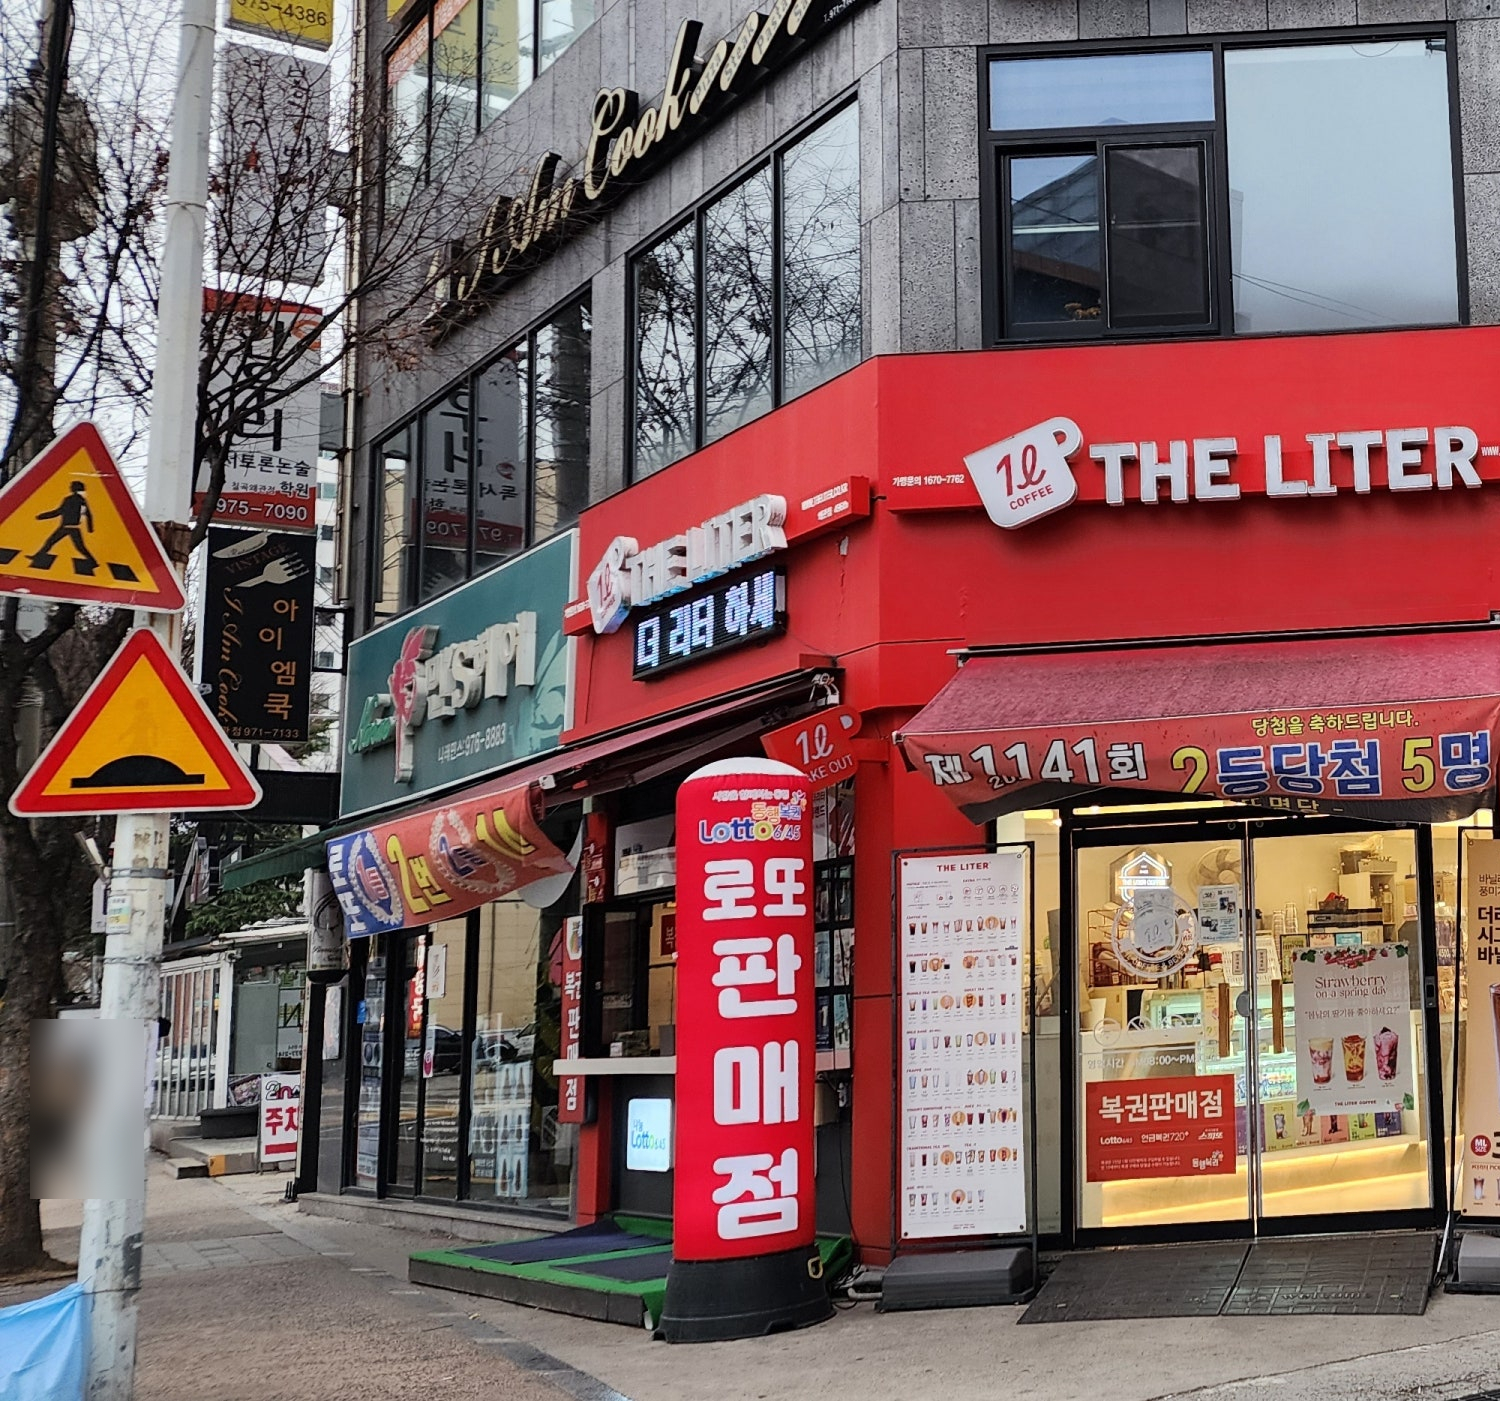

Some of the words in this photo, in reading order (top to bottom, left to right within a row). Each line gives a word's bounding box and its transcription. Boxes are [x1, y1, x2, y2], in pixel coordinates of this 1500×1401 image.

[1088, 436, 1242, 505] THE
[1264, 425, 1483, 497] LITER
[279, 480, 310, 499] 학원
[892, 475, 922, 487] 가맹문의
[924, 473, 965, 486] 1670-7762
[215, 496, 309, 522] 975-7090
[1008, 484, 1055, 511] COFFEE
[626, 534, 690, 607] THE
[686, 494, 788, 582] LITER
[635, 616, 661, 667] 더
[669, 595, 715, 656] 리터
[244, 726, 300, 738] 971-7133
[1251, 714, 1305, 736] 당첨을
[1308, 709, 1420, 735] 축하드립니다.
[828, 754, 853, 775] OUT
[698, 817, 774, 845] Lotto
[936, 863, 956, 873] THE
[960, 862, 990, 871] LITER
[702, 856, 807, 921] 로또
[1314, 974, 1389, 990] Strawberry
[1315, 989, 1329, 999] on
[1339, 987, 1369, 1000] spring
[1371, 985, 1388, 997] day
[1099, 1088, 1223, 1124] 복권판매점
[1100, 1135, 1123, 1146] Lotto
